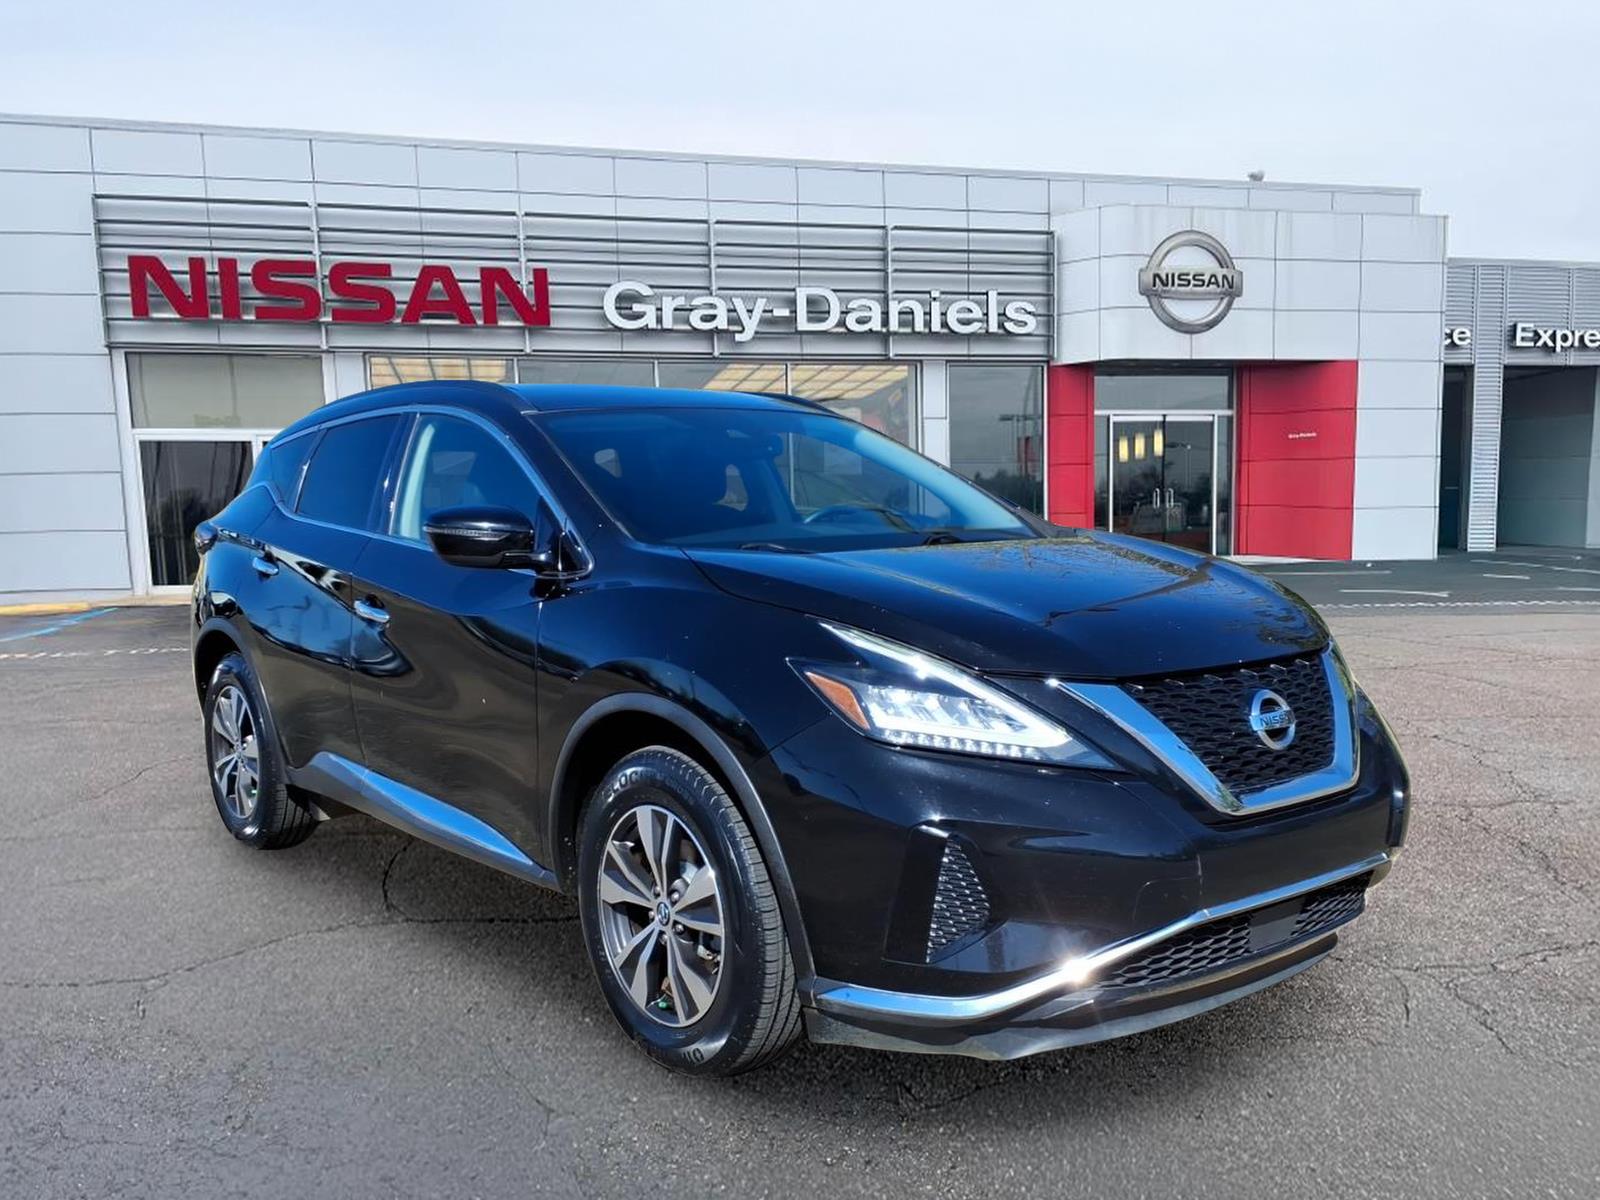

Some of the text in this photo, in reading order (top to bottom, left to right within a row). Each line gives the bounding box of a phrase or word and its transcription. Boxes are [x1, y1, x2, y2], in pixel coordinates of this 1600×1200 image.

[127, 255, 551, 327] NISSAN
[1152, 272, 1235, 289] NISSAN
[603, 281, 1038, 341] Gray-Daniels
